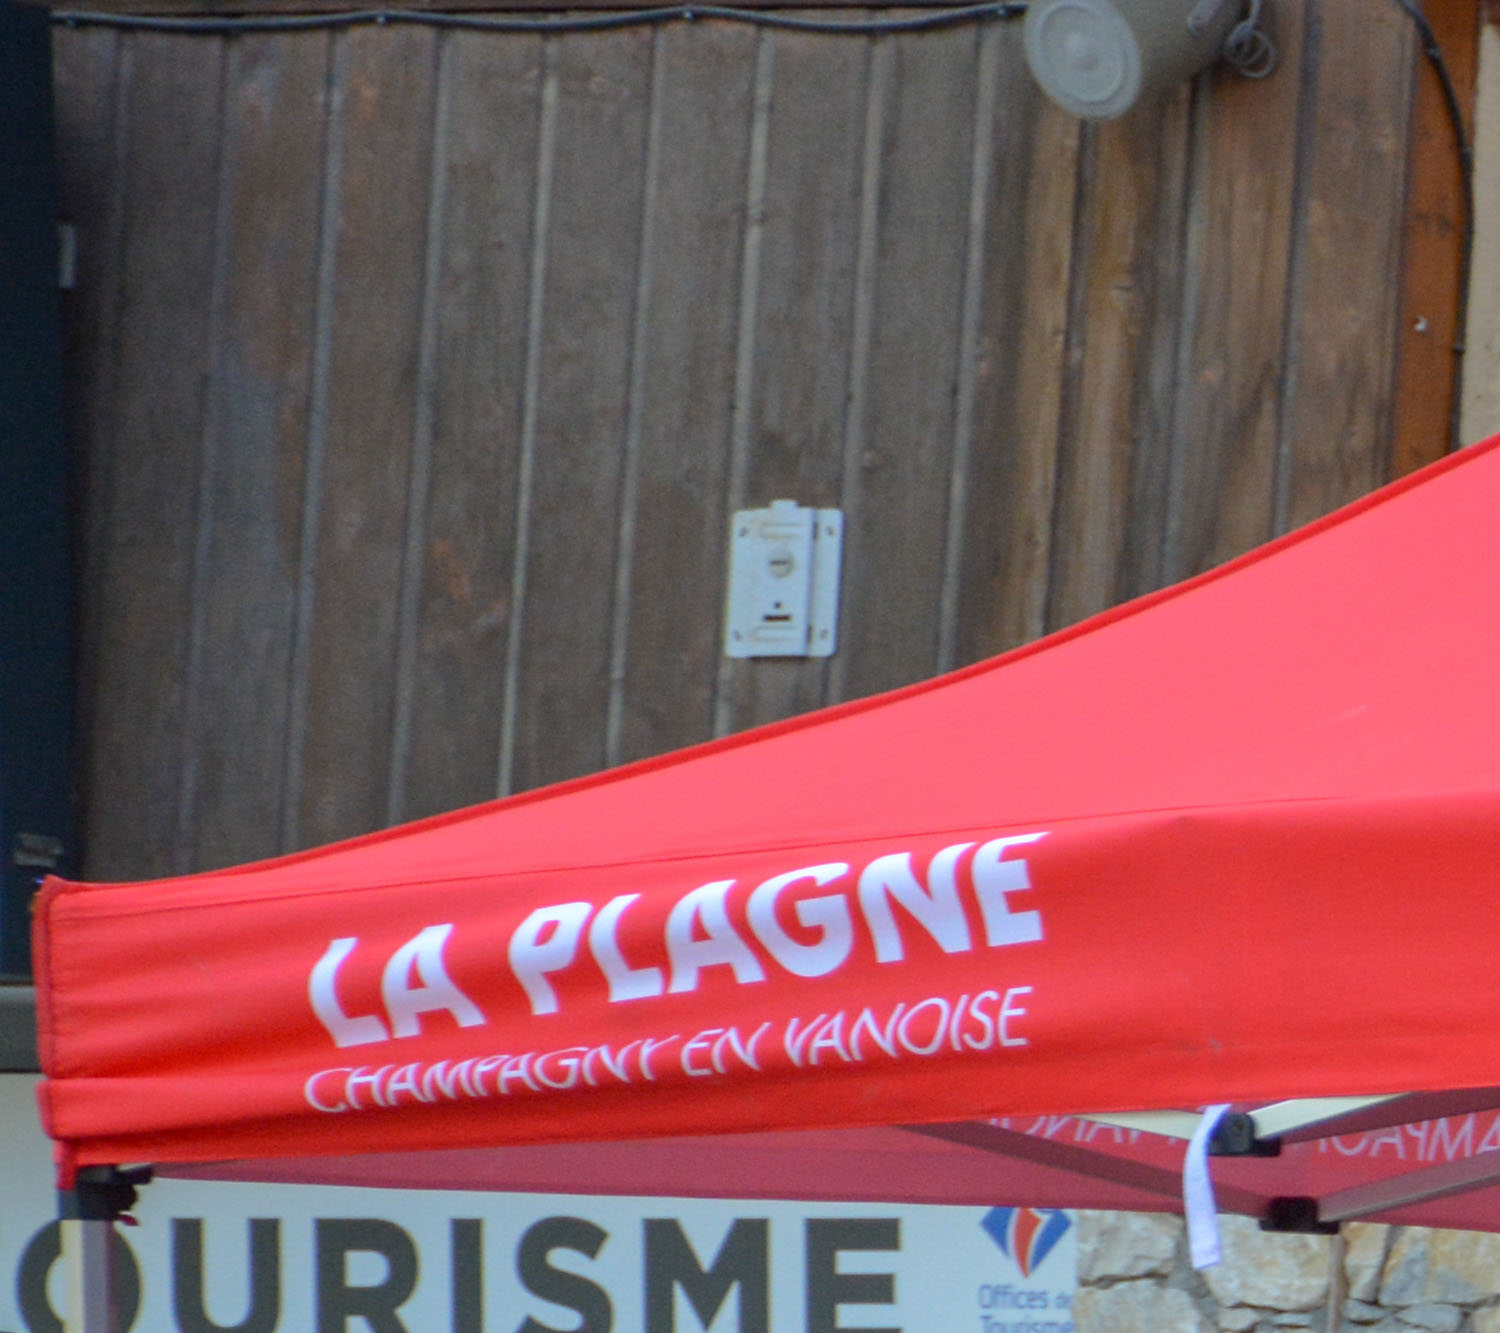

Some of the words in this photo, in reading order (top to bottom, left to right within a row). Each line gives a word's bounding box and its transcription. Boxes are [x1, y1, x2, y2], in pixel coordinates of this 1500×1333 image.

[308, 924, 485, 1048] LA
[507, 832, 1050, 1016] PLAGNE
[304, 1033, 678, 1115] CHAMPAGNY
[681, 1019, 771, 1078] EN
[784, 987, 1032, 1066] VANOISE
[979, 1284, 1048, 1309] Offices
